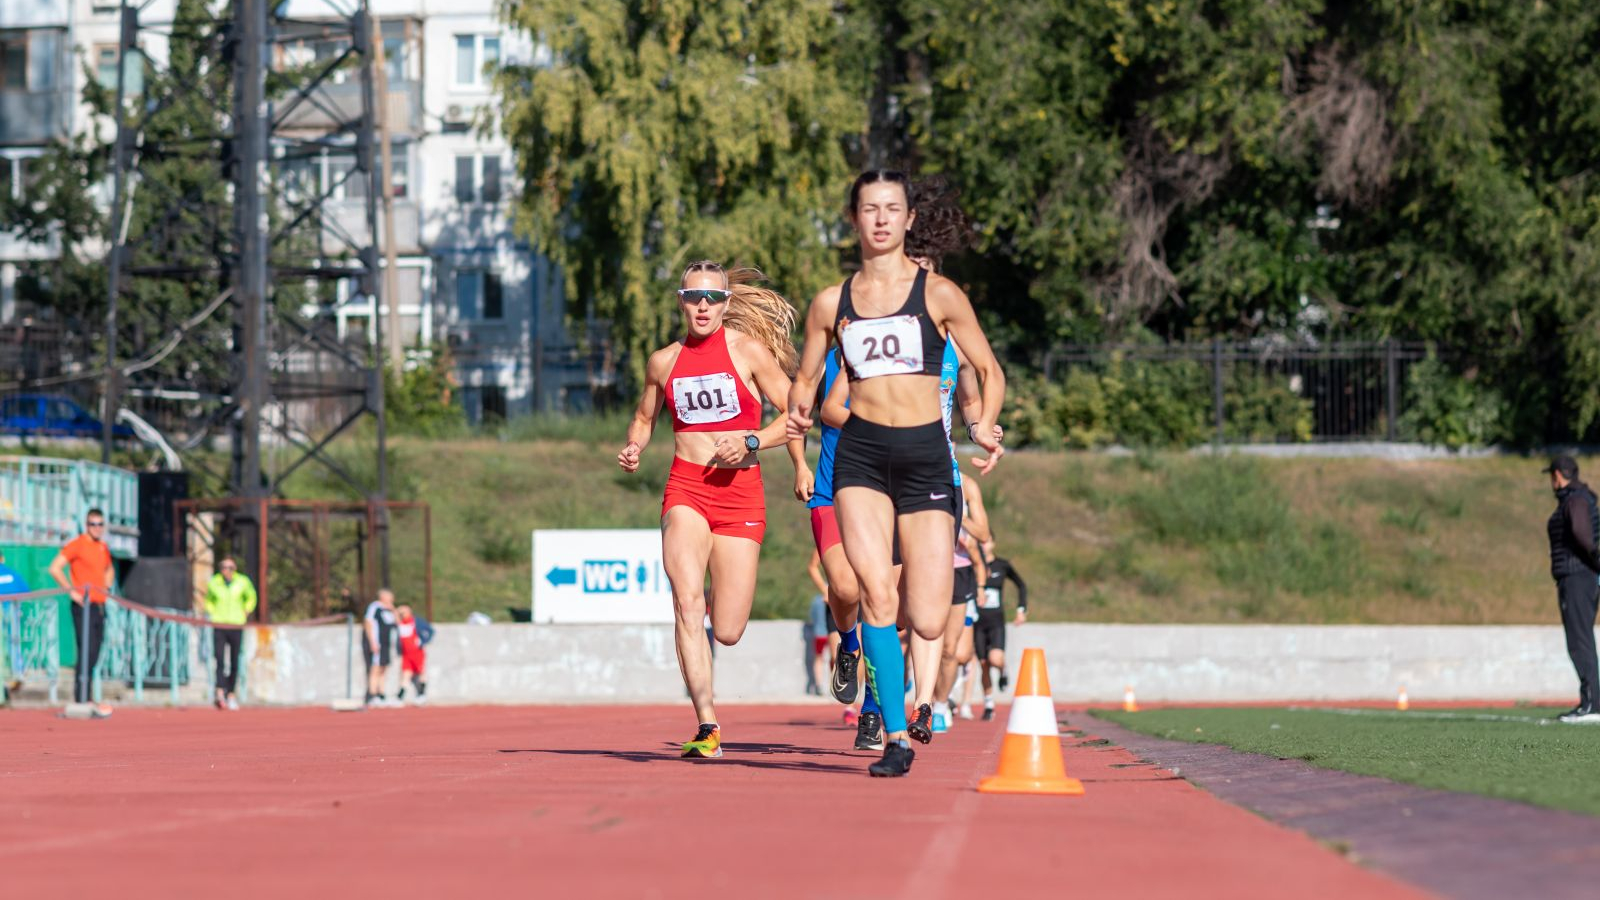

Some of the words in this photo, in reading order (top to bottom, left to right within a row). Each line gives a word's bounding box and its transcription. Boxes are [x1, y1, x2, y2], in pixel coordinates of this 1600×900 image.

[862, 334, 900, 361] 20
[684, 388, 727, 411] 101
[585, 562, 627, 590] WC
